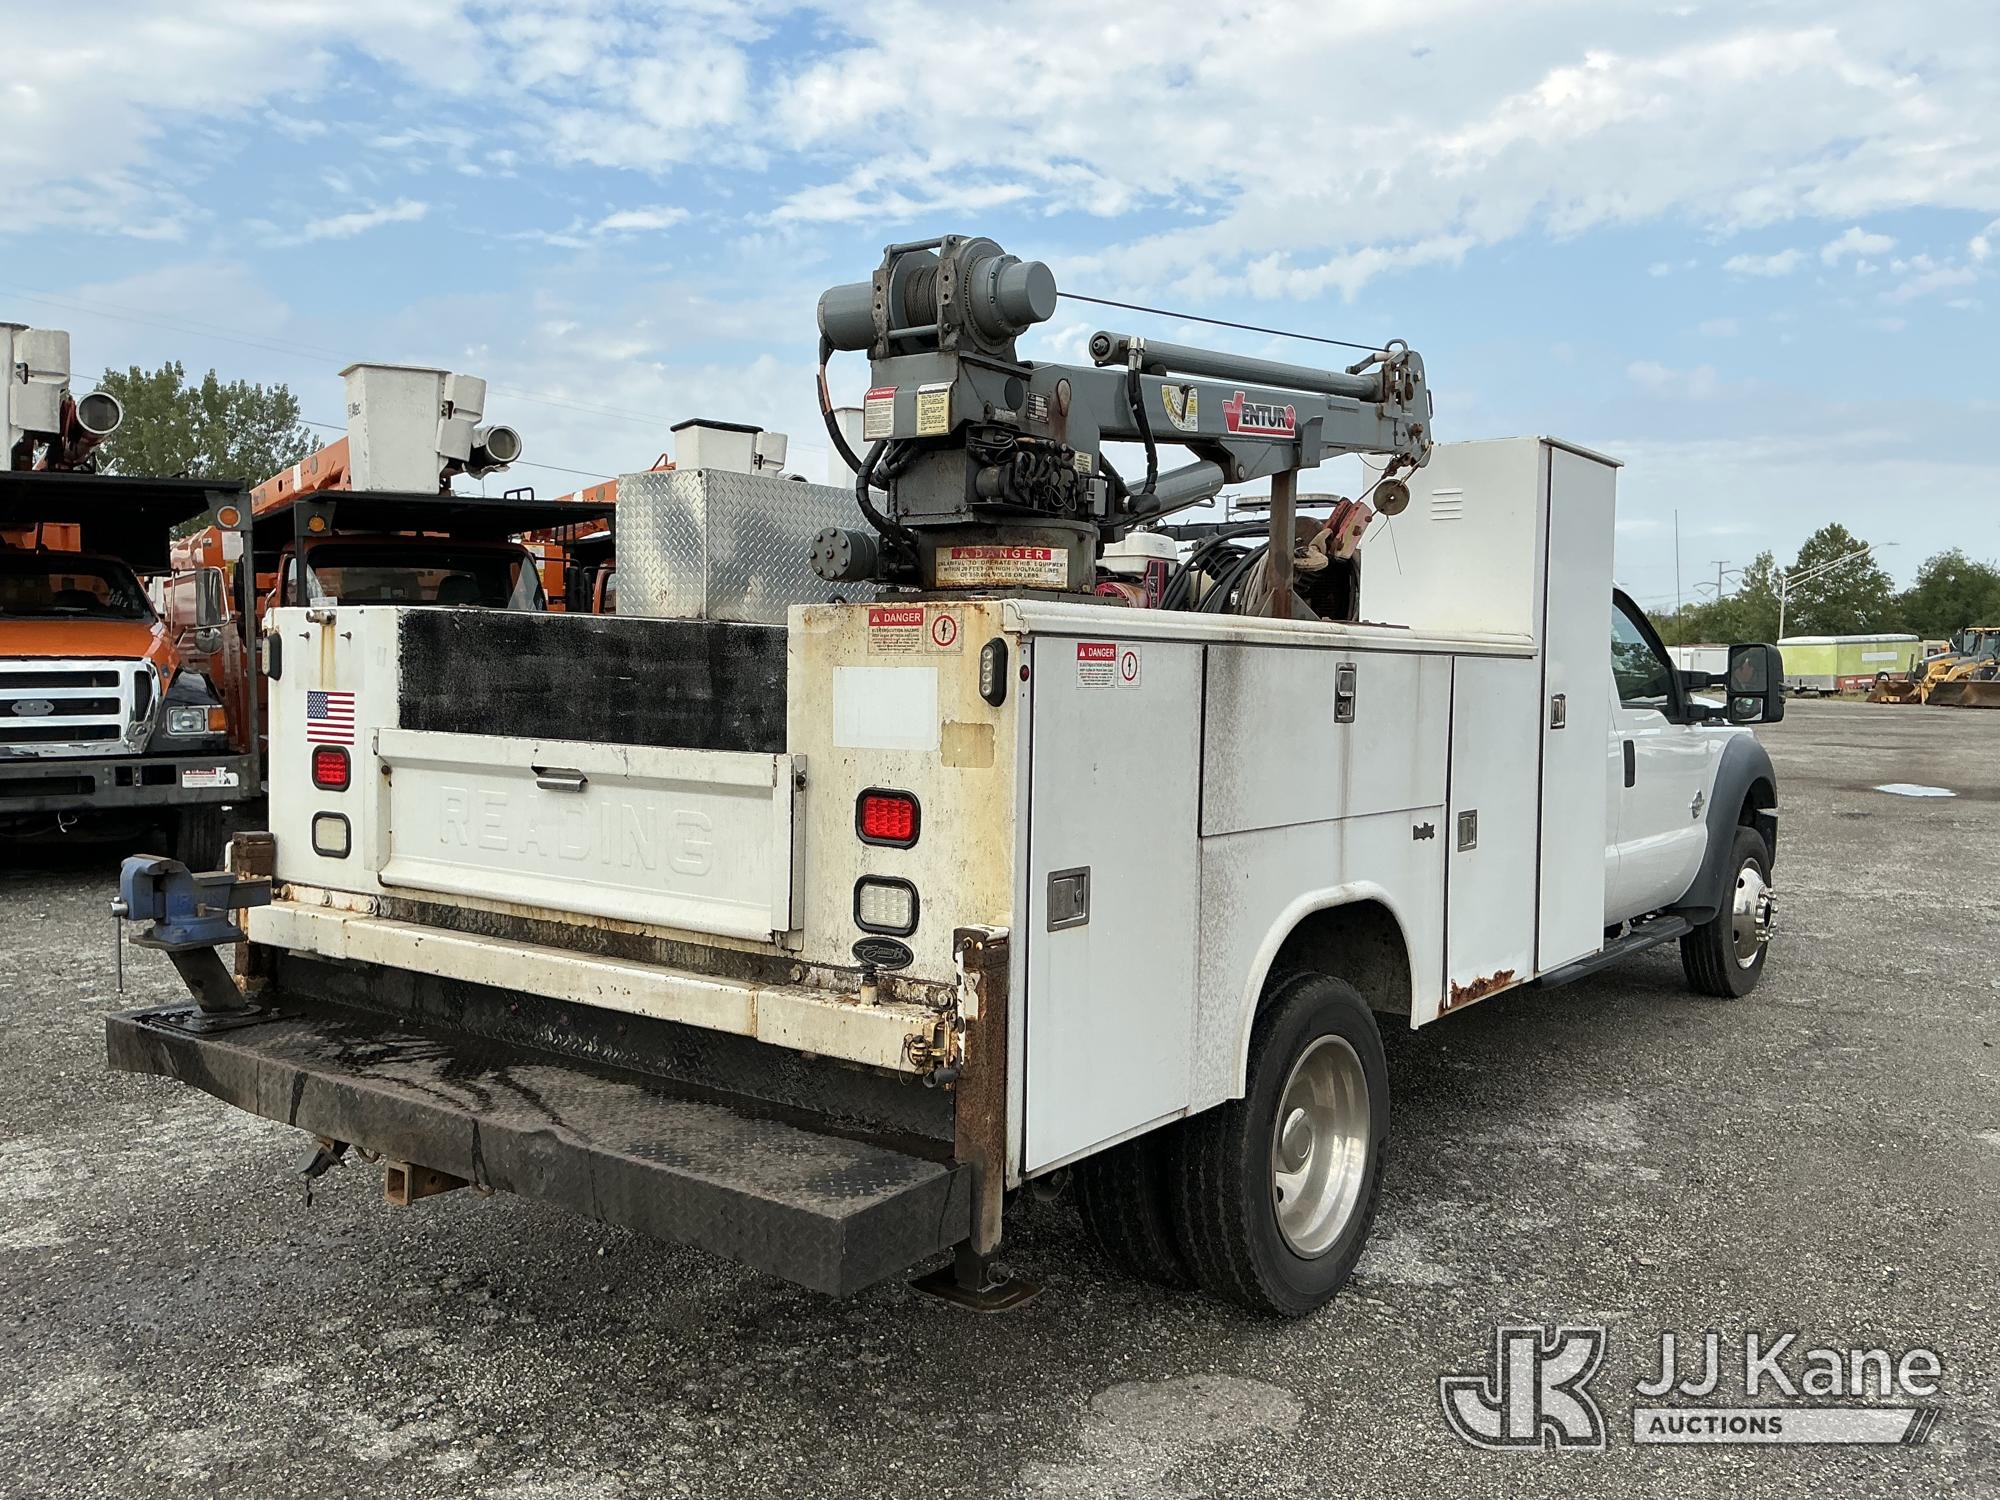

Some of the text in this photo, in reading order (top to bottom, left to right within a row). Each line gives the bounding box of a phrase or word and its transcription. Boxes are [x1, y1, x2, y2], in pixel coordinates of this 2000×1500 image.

[1223, 392, 1296, 433] VENTURO
[975, 550, 1044, 559] DANGER
[884, 613, 921, 622] DANGER
[1088, 648, 1114, 657] DANGER
[440, 786, 713, 876] READING
